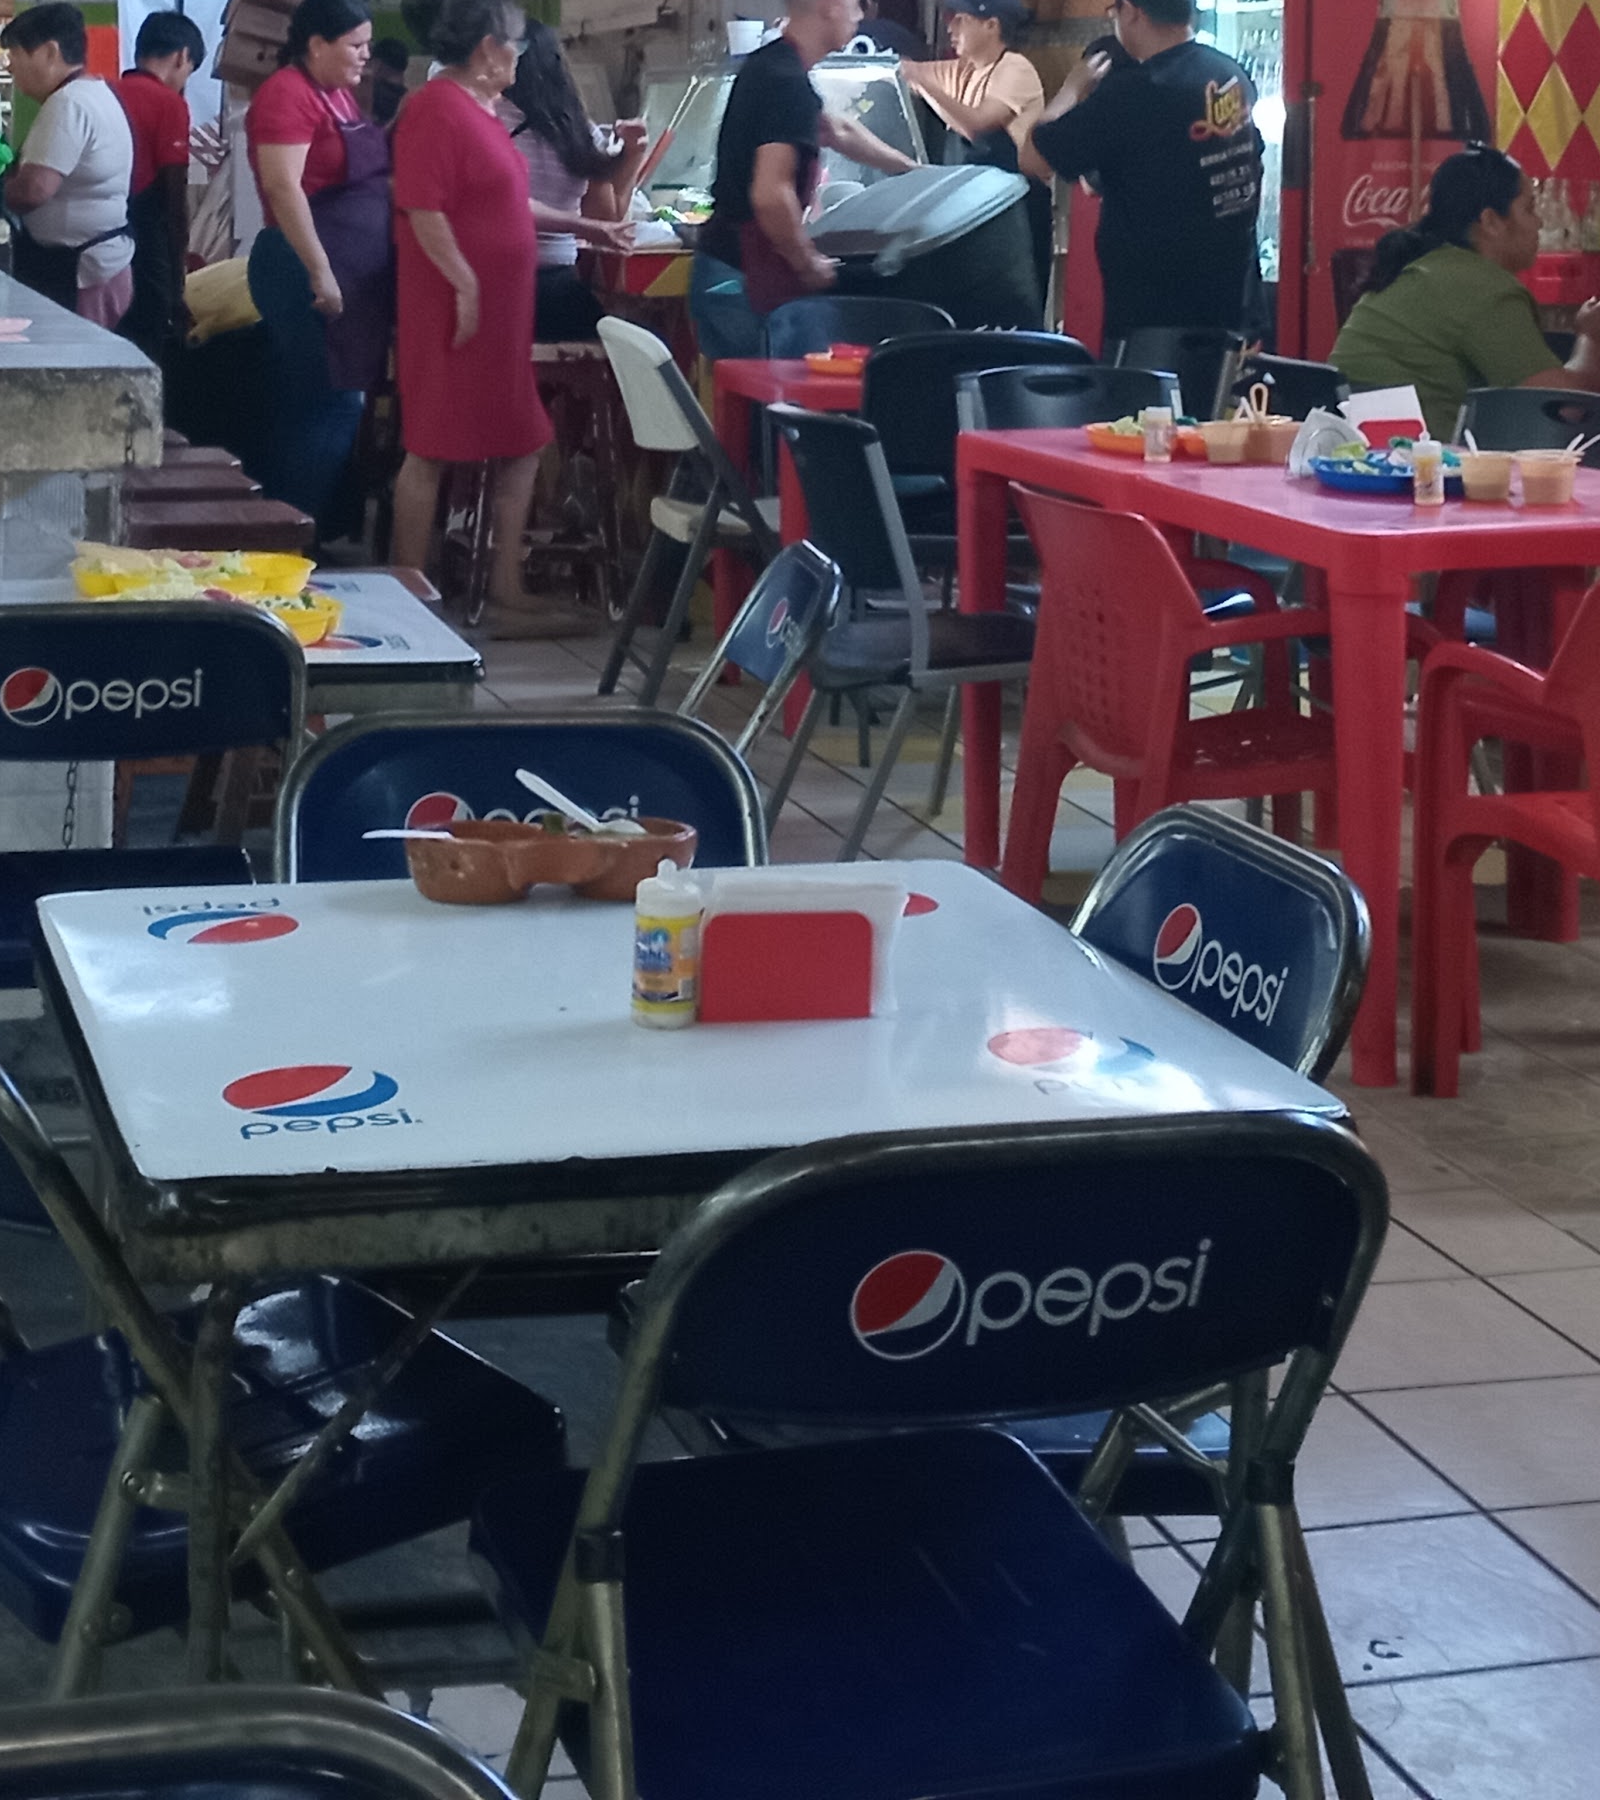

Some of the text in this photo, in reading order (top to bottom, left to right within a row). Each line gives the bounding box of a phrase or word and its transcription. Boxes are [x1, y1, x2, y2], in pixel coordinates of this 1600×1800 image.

[65, 669, 203, 719] pepsi
[1190, 938, 1290, 1027] pepsi
[240, 1107, 415, 1141] pepsi
[966, 1239, 1212, 1346] pepsi
